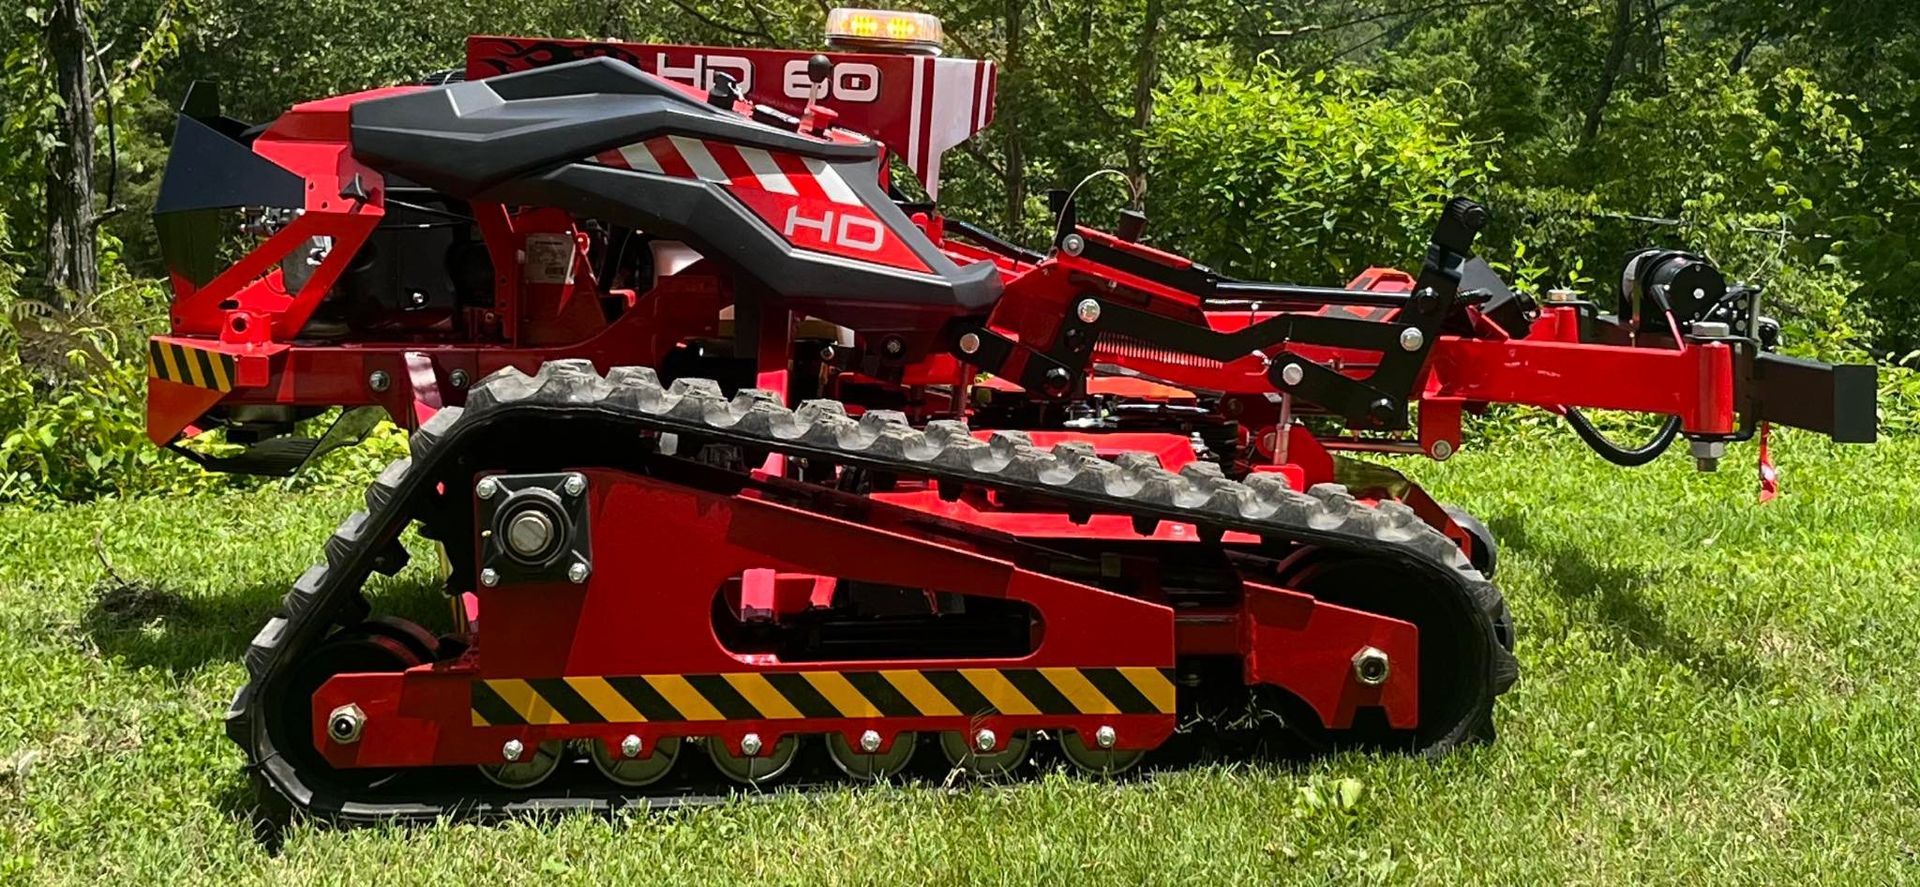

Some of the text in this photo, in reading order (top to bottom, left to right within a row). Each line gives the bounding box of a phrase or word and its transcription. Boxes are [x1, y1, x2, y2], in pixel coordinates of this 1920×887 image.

[657, 52, 879, 102] HD 60
[784, 205, 884, 252] HD
